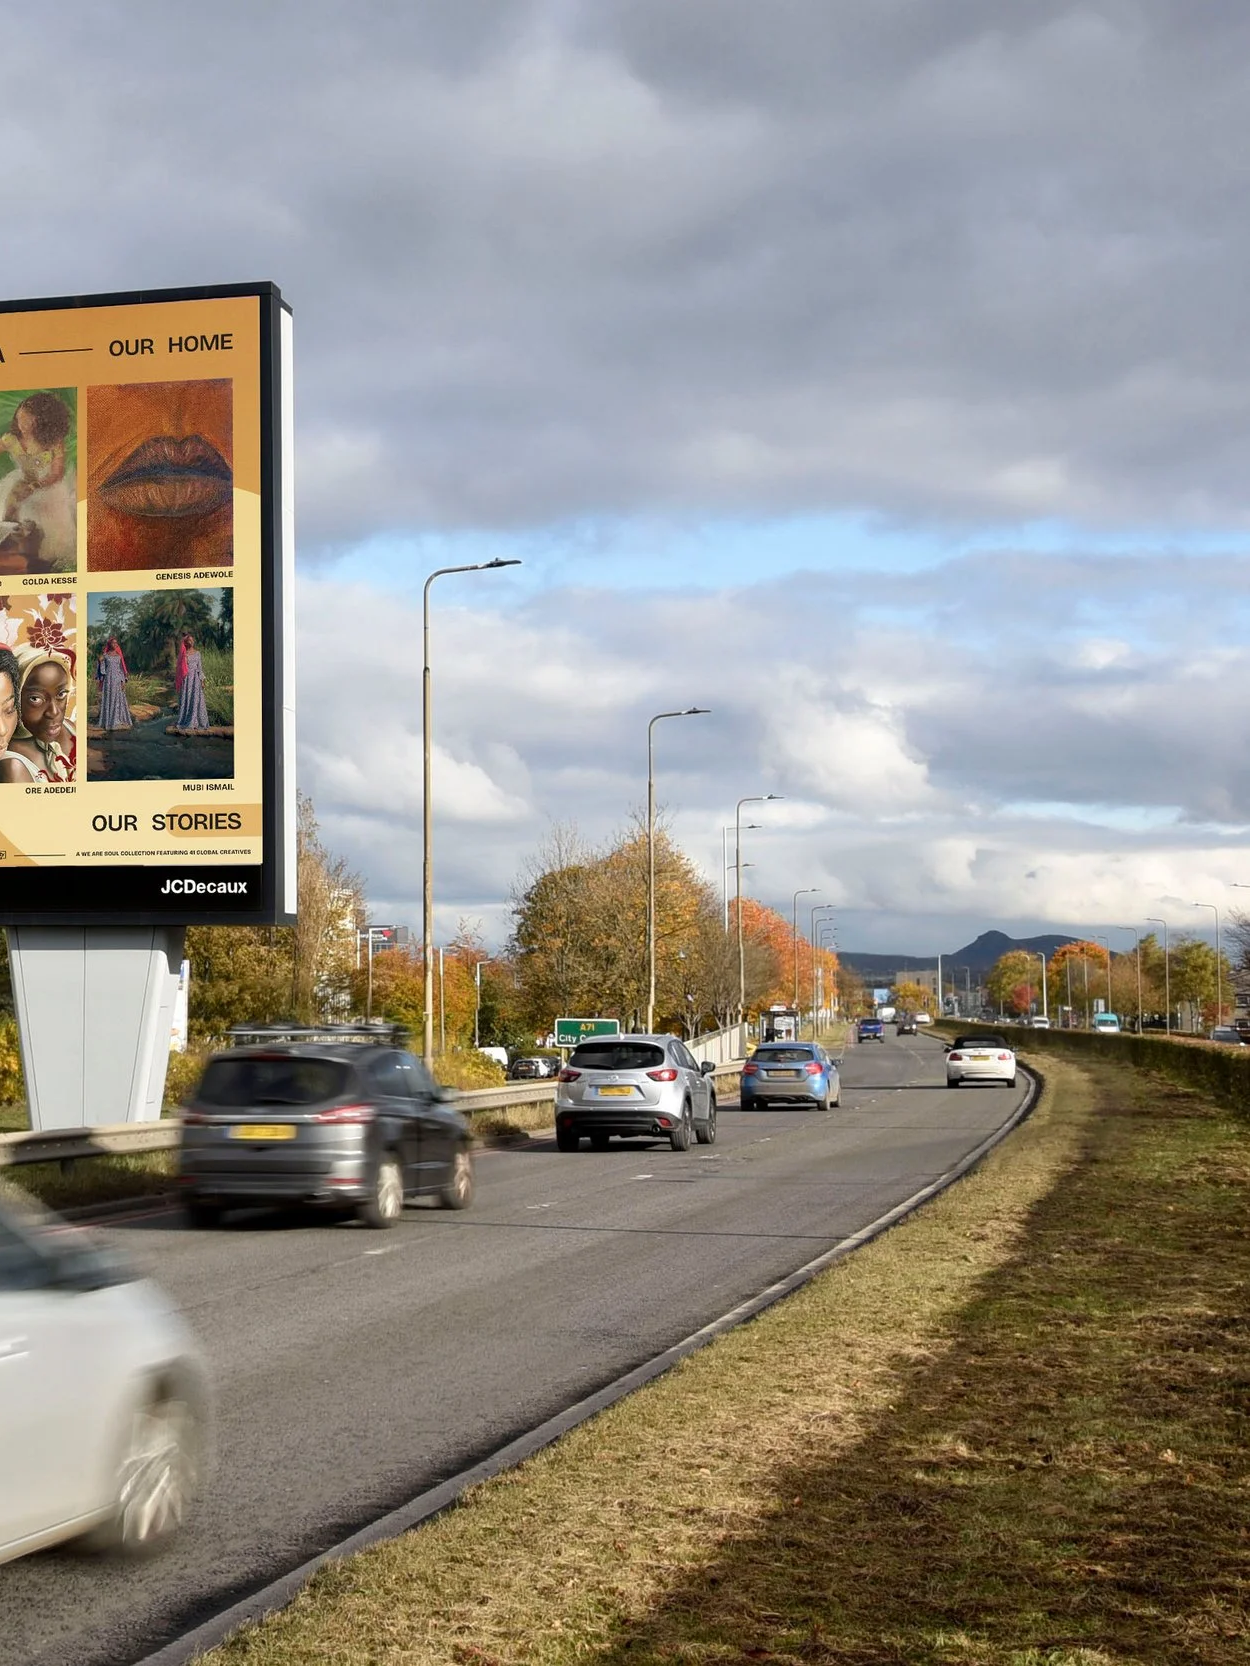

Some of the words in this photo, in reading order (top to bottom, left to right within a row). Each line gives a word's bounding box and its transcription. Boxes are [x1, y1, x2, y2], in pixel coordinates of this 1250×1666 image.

[109, 338, 154, 356] OUR
[168, 333, 233, 353] HOME
[156, 572, 191, 580] GENESIS
[22, 578, 49, 586] GOLDA
[51, 576, 78, 585] KESSE
[44, 786, 77, 794] ADEDEJI
[182, 784, 204, 792] MUBI
[206, 783, 235, 791] ISMAIL
[92, 814, 138, 832] OUR
[151, 812, 242, 831] STORIES
[161, 879, 247, 894] JCDecaux
[580, 1023, 595, 1031] A71
[559, 1034, 577, 1043] City
